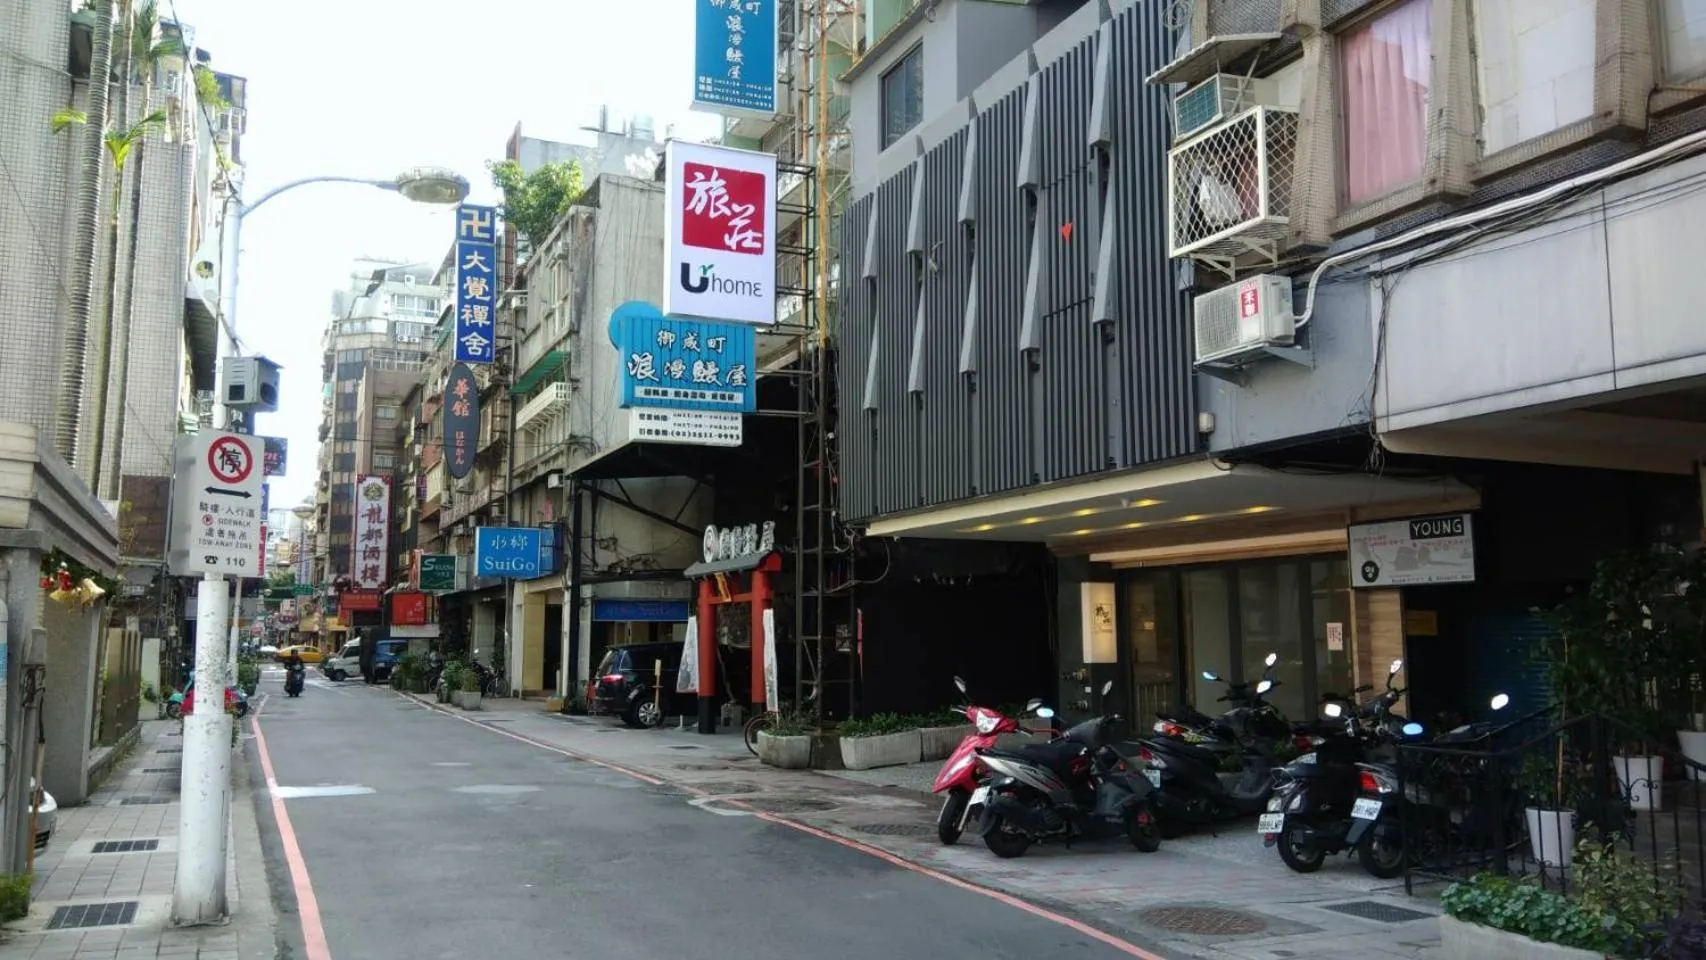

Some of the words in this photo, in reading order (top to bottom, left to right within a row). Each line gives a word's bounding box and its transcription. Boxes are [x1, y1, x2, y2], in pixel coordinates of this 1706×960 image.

[685, 168, 762, 250] 旅莊
[460, 251, 491, 356] 大覺禪舍
[1411, 519, 1462, 536] YOUNG
[226, 557, 245, 567] 110
[484, 556, 535, 571] SuiGo
